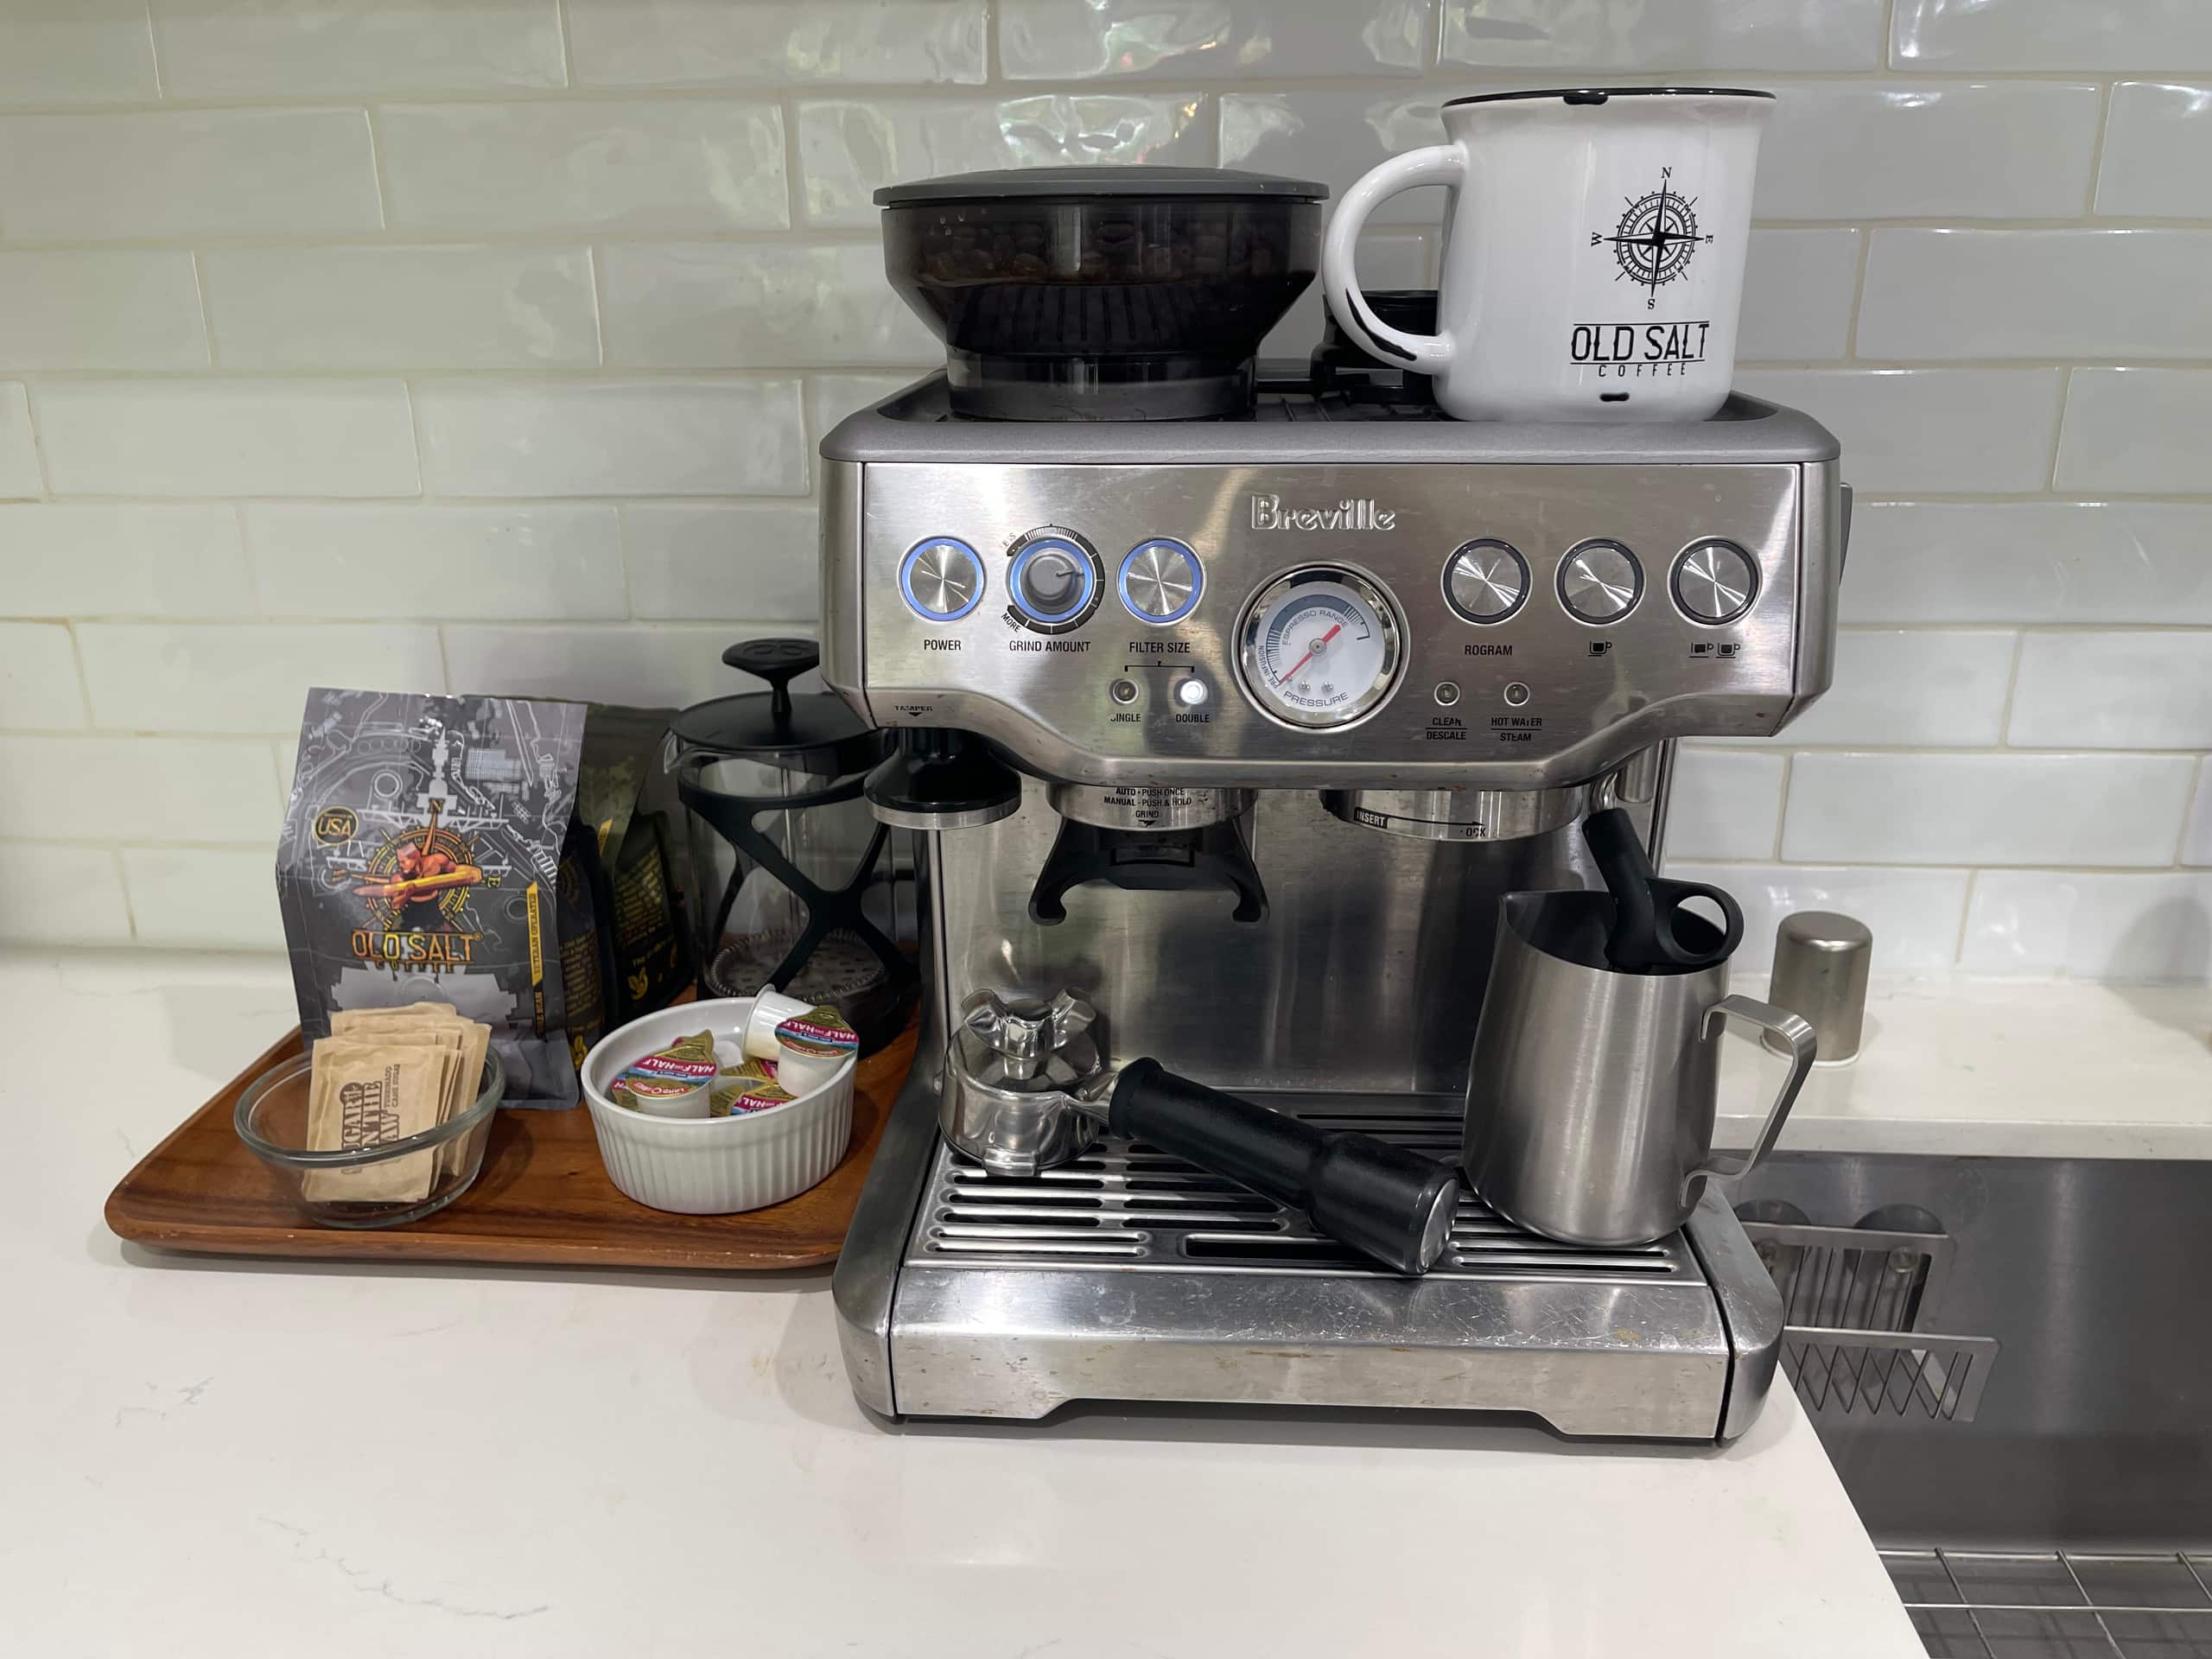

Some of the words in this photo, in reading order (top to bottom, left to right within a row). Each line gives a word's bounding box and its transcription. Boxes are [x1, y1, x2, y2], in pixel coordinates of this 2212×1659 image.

[1661, 167, 1672, 179] N
[1647, 298, 1656, 309] S
[1571, 326, 1634, 361] OLD
[1643, 323, 1710, 360] SALT
[1599, 363, 1686, 378] COFFEE
[1251, 494, 1396, 531] Breville
[1001, 613, 1020, 632] MORE
[1282, 610, 1317, 646] ESPRESSO
[1319, 609, 1348, 628] RANGE
[924, 639, 962, 651] POWER
[1009, 639, 1042, 652] GRIND
[1045, 640, 1091, 652] AMOUNT
[1129, 642, 1164, 653] FILTER
[1167, 642, 1191, 653] SIZE
[1258, 645, 1279, 690] PRE-INFUSION
[1283, 690, 1349, 707] PRESSURE
[1176, 714, 1210, 723] DOUBLE
[1433, 717, 1462, 727] CLEAN
[1491, 717, 1510, 727] HOT
[1427, 731, 1466, 741] DESCALE
[1500, 733, 1532, 741] STEAM
[1116, 787, 1136, 796] AUTO
[1142, 788, 1162, 797] PUSH
[1164, 787, 1185, 796] ONCE
[1104, 796, 1135, 806] MANUAL
[1142, 798, 1162, 807] PUSH
[1172, 797, 1192, 806] HOLD
[1135, 810, 1159, 818] GRIND
[1356, 810, 1385, 827] INSERT
[317, 816, 352, 836] USA
[1460, 828, 1486, 837] OCK
[823, 1029, 856, 1040] HALF
[642, 1058, 675, 1070] HALF
[683, 1065, 715, 1073] HALF
